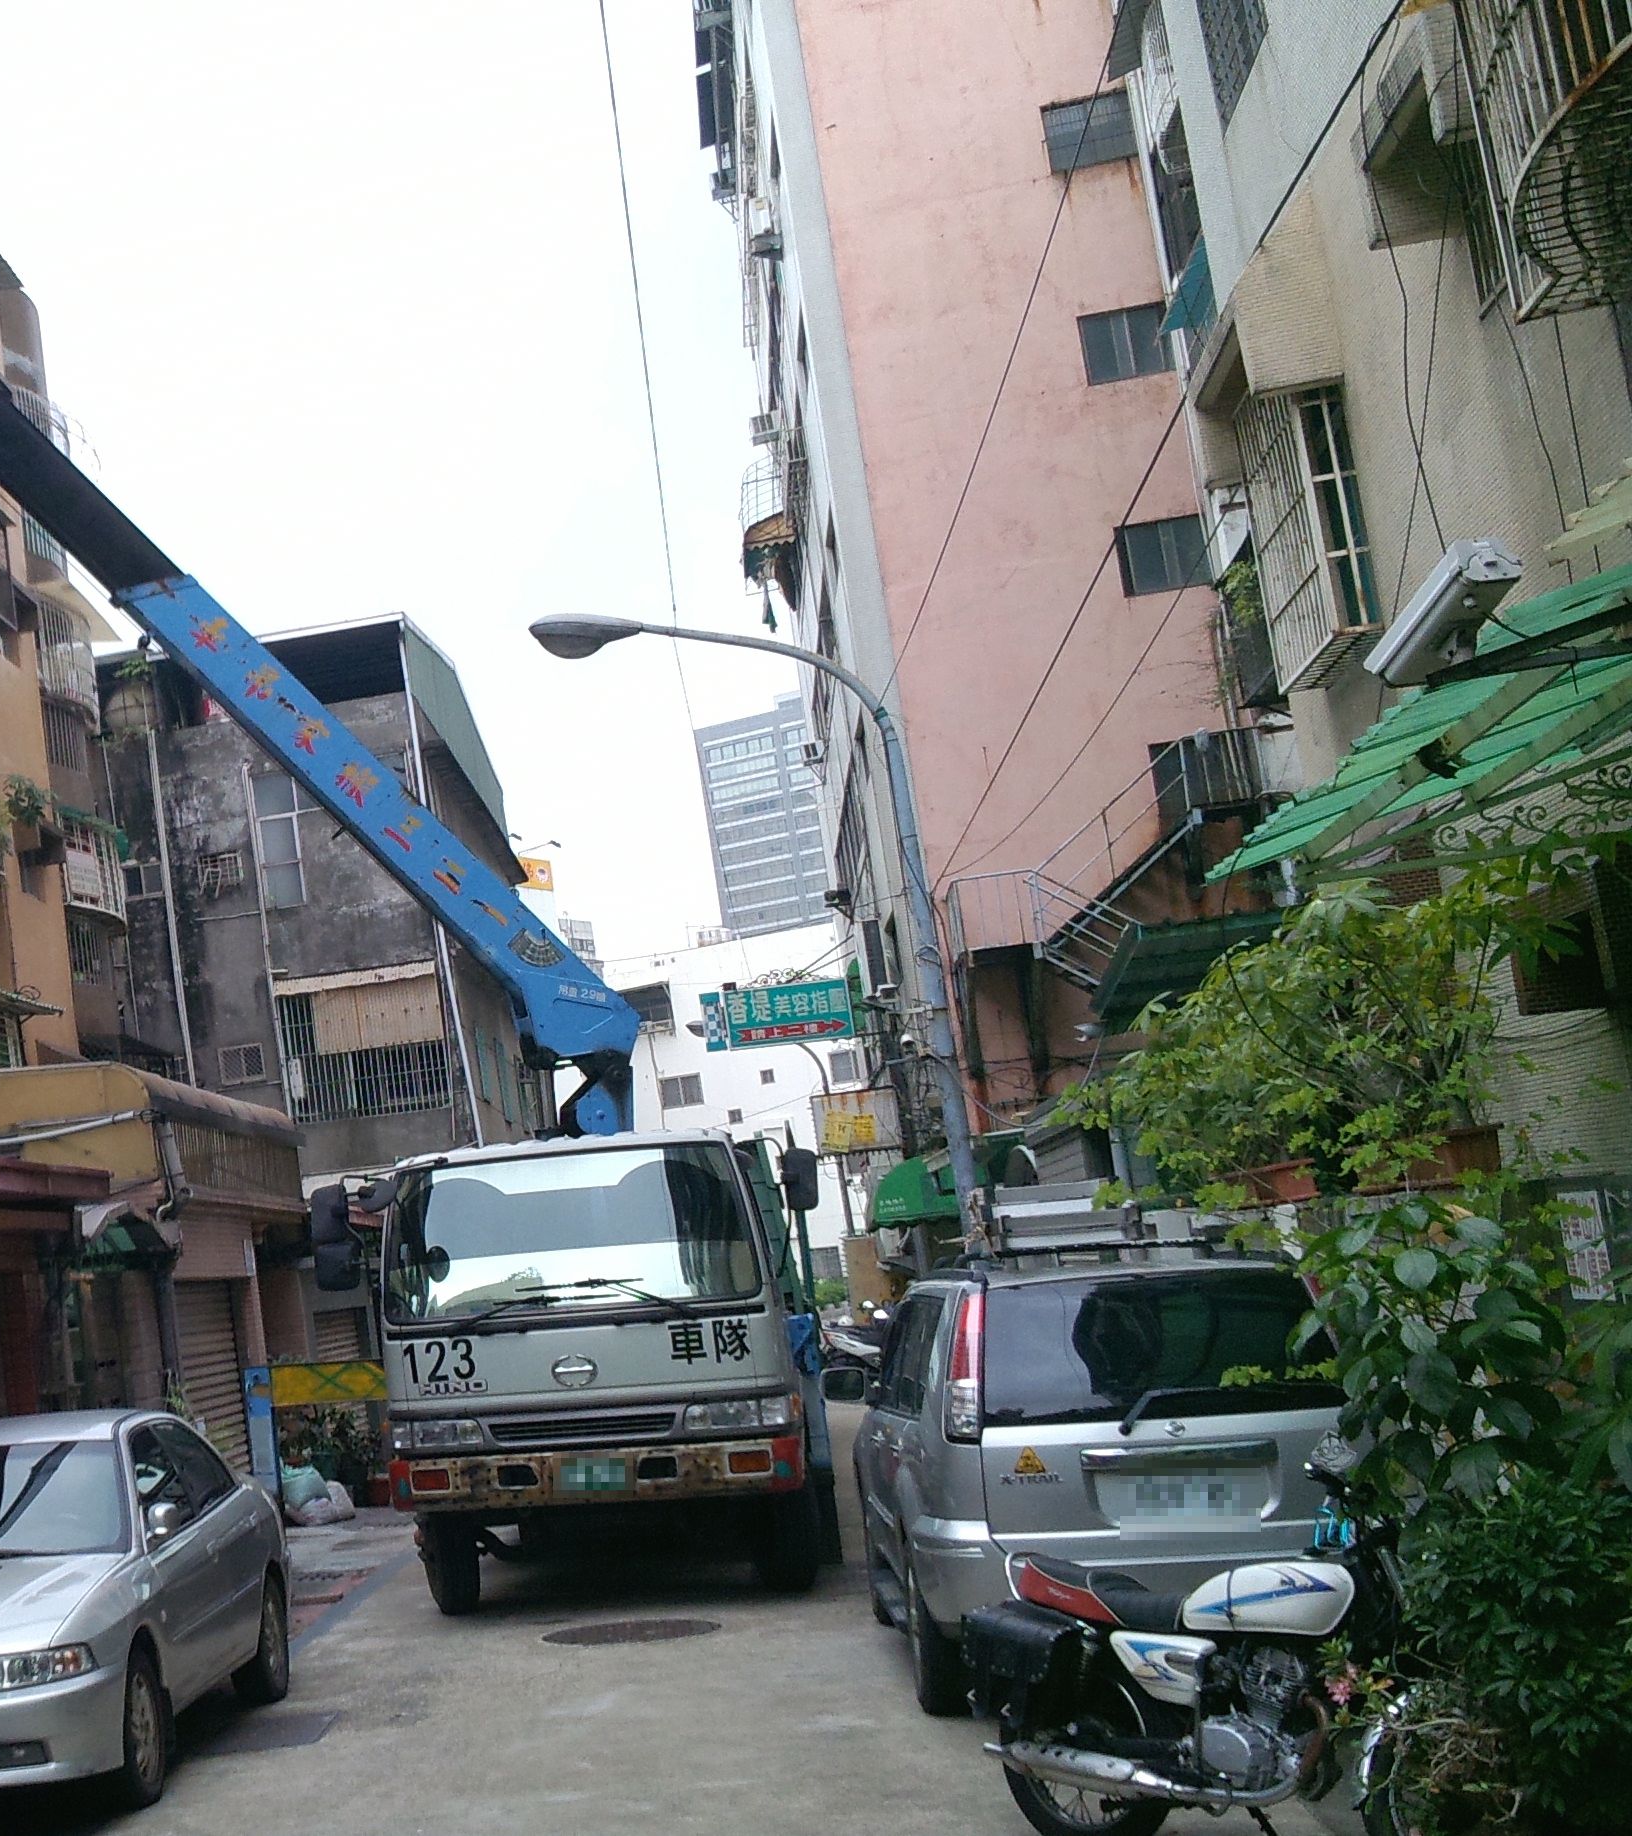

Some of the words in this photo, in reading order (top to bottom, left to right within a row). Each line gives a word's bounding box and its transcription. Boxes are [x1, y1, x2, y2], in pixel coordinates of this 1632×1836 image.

[667, 1318, 751, 1365] 車隊
[403, 1338, 476, 1384] 123
[419, 1380, 488, 1395] HINO
[999, 1472, 1064, 1486] X-TRAIL
